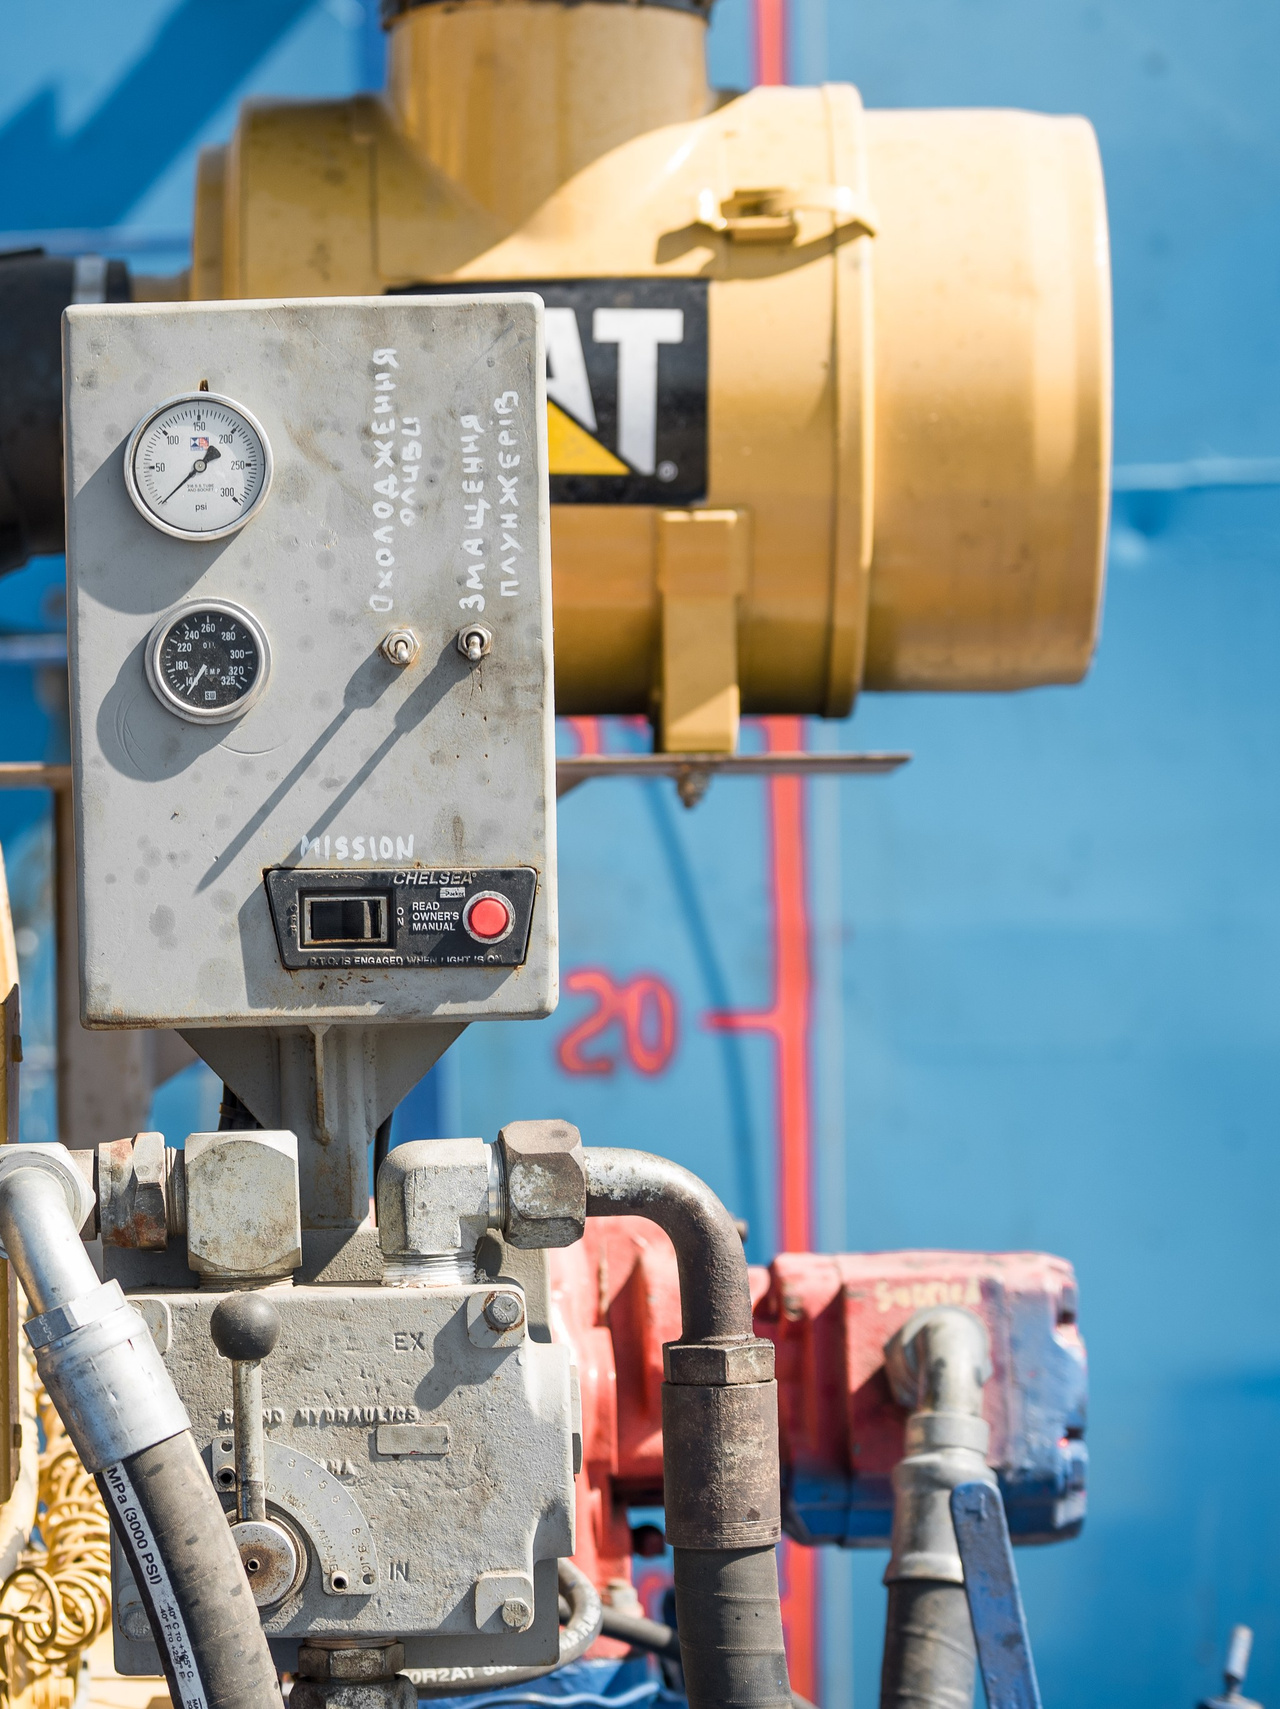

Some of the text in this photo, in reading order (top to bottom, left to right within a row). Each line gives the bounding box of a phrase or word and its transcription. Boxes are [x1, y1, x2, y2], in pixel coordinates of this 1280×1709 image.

[544, 306, 684, 476] AT
[193, 421, 206, 432] 150
[166, 435, 180, 445] 100
[219, 434, 233, 444] 200
[155, 462, 166, 473] 50
[231, 460, 245, 471] 250
[220, 487, 235, 498] 300
[195, 502, 208, 512] psi
[459, 414, 491, 612] ЗМАЩЕННЯ
[201, 623, 216, 633] 260
[184, 630, 199, 640] 240
[221, 631, 236, 641] 280
[177, 642, 192, 652] 220
[230, 649, 245, 659] 300
[175, 660, 189, 670] 180
[228, 666, 244, 675] 320
[220, 676, 236, 686] 325
[300, 834, 415, 862] MISSION
[412, 901, 440, 911] READ
[412, 911, 460, 921] OWNER'S
[412, 922, 456, 931] MANUAL
[354, 956, 404, 966] ENGAGED
[556, 967, 678, 1077] 20
[392, 1331, 425, 1352] EX
[222, 1405, 422, 1425] BND HYDRAULICS
[287, 1459, 297, 1469] 3
[303, 1468, 313, 1479] 4
[318, 1480, 328, 1490] 5
[351, 1527, 361, 1536] 8
[107, 1466, 163, 1585] MPa (3000 PSI)
[388, 1561, 410, 1583] IN
[172, 1622, 180, 1630] C
